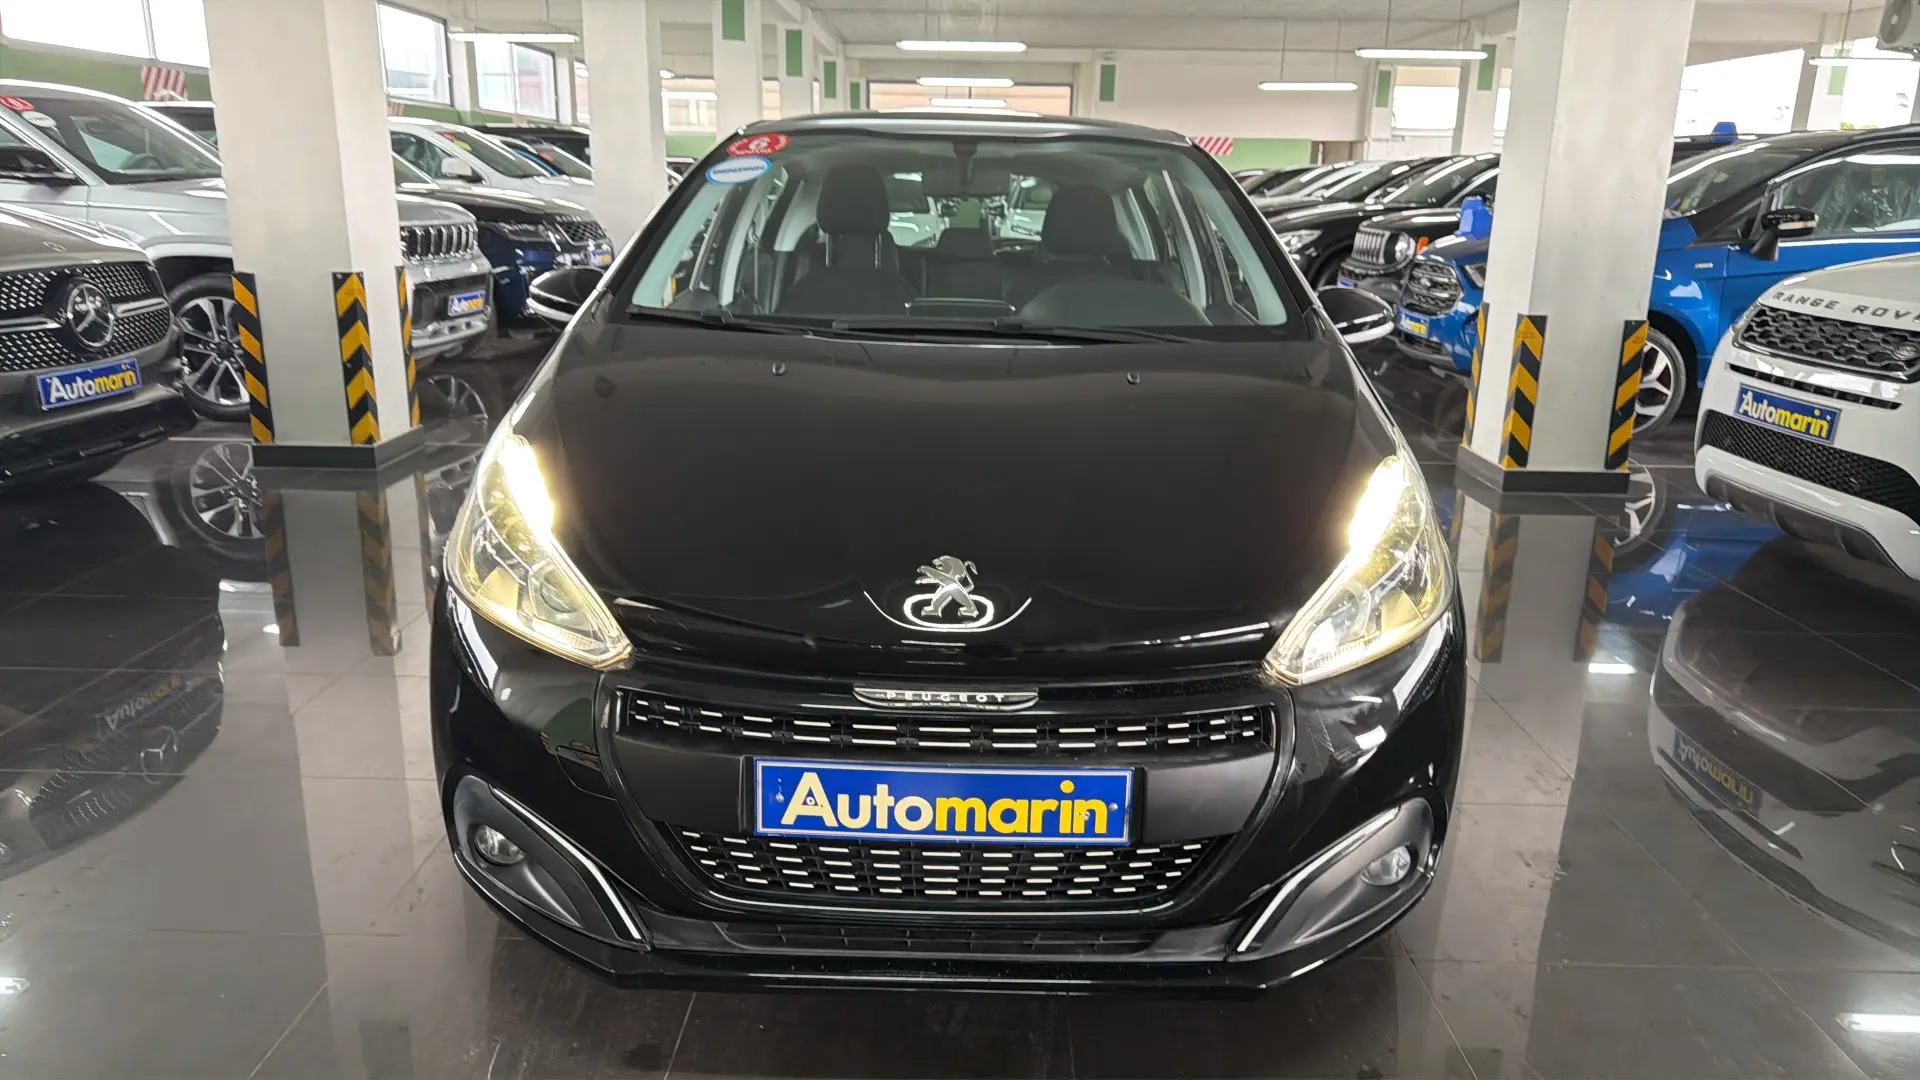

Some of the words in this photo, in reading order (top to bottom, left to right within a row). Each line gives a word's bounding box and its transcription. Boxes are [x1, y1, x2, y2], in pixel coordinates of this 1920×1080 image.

[1772, 291, 1840, 310] RANGE
[49, 364, 137, 403] Automarin
[1739, 390, 1830, 439] Automarin
[886, 690, 1005, 703] PEUGEOT
[780, 771, 1108, 834] Automarin
